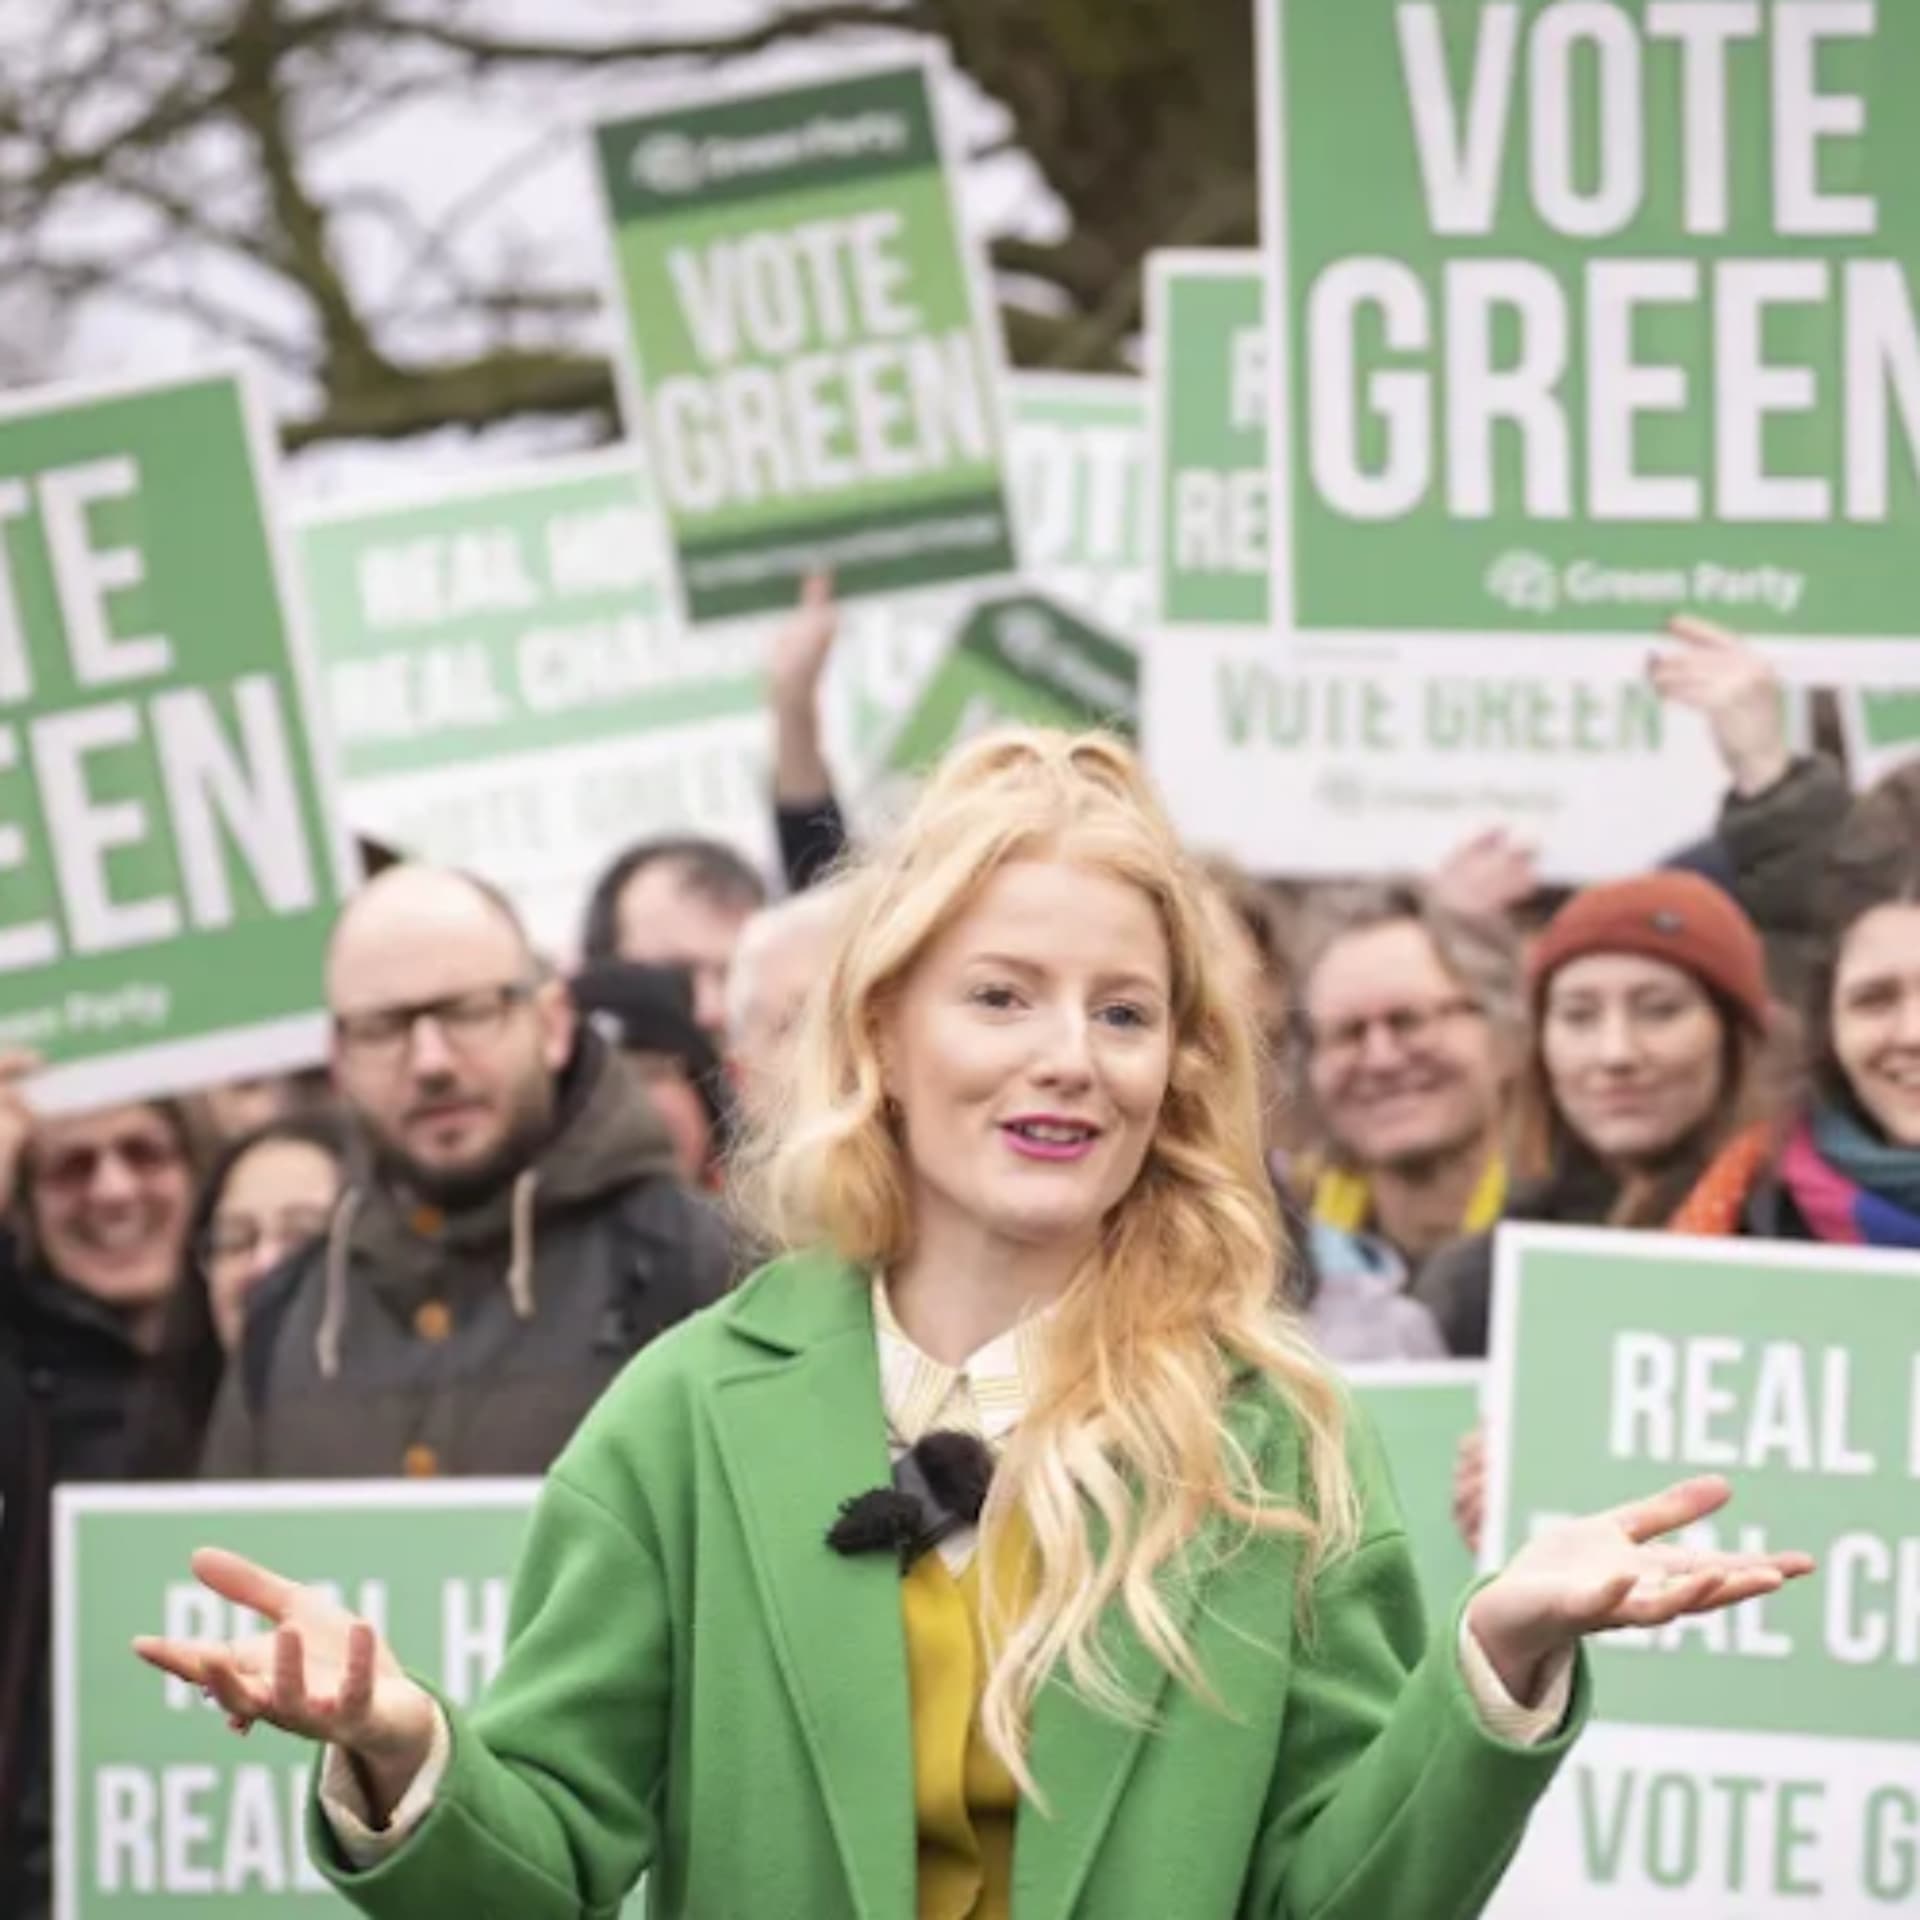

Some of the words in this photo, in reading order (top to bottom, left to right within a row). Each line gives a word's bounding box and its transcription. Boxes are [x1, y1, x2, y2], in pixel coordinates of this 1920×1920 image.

[1395, 0, 1879, 238] VOTE
[664, 208, 924, 370] VOTE
[650, 328, 994, 516] GREEN
[1306, 255, 1920, 523] GREEN
[1563, 560, 1686, 604] Green
[1693, 560, 1806, 614] Party
[1608, 1329, 1878, 1477] REAL
[94, 1763, 332, 1895] REAL
[1575, 1766, 1827, 1898] VOTE
